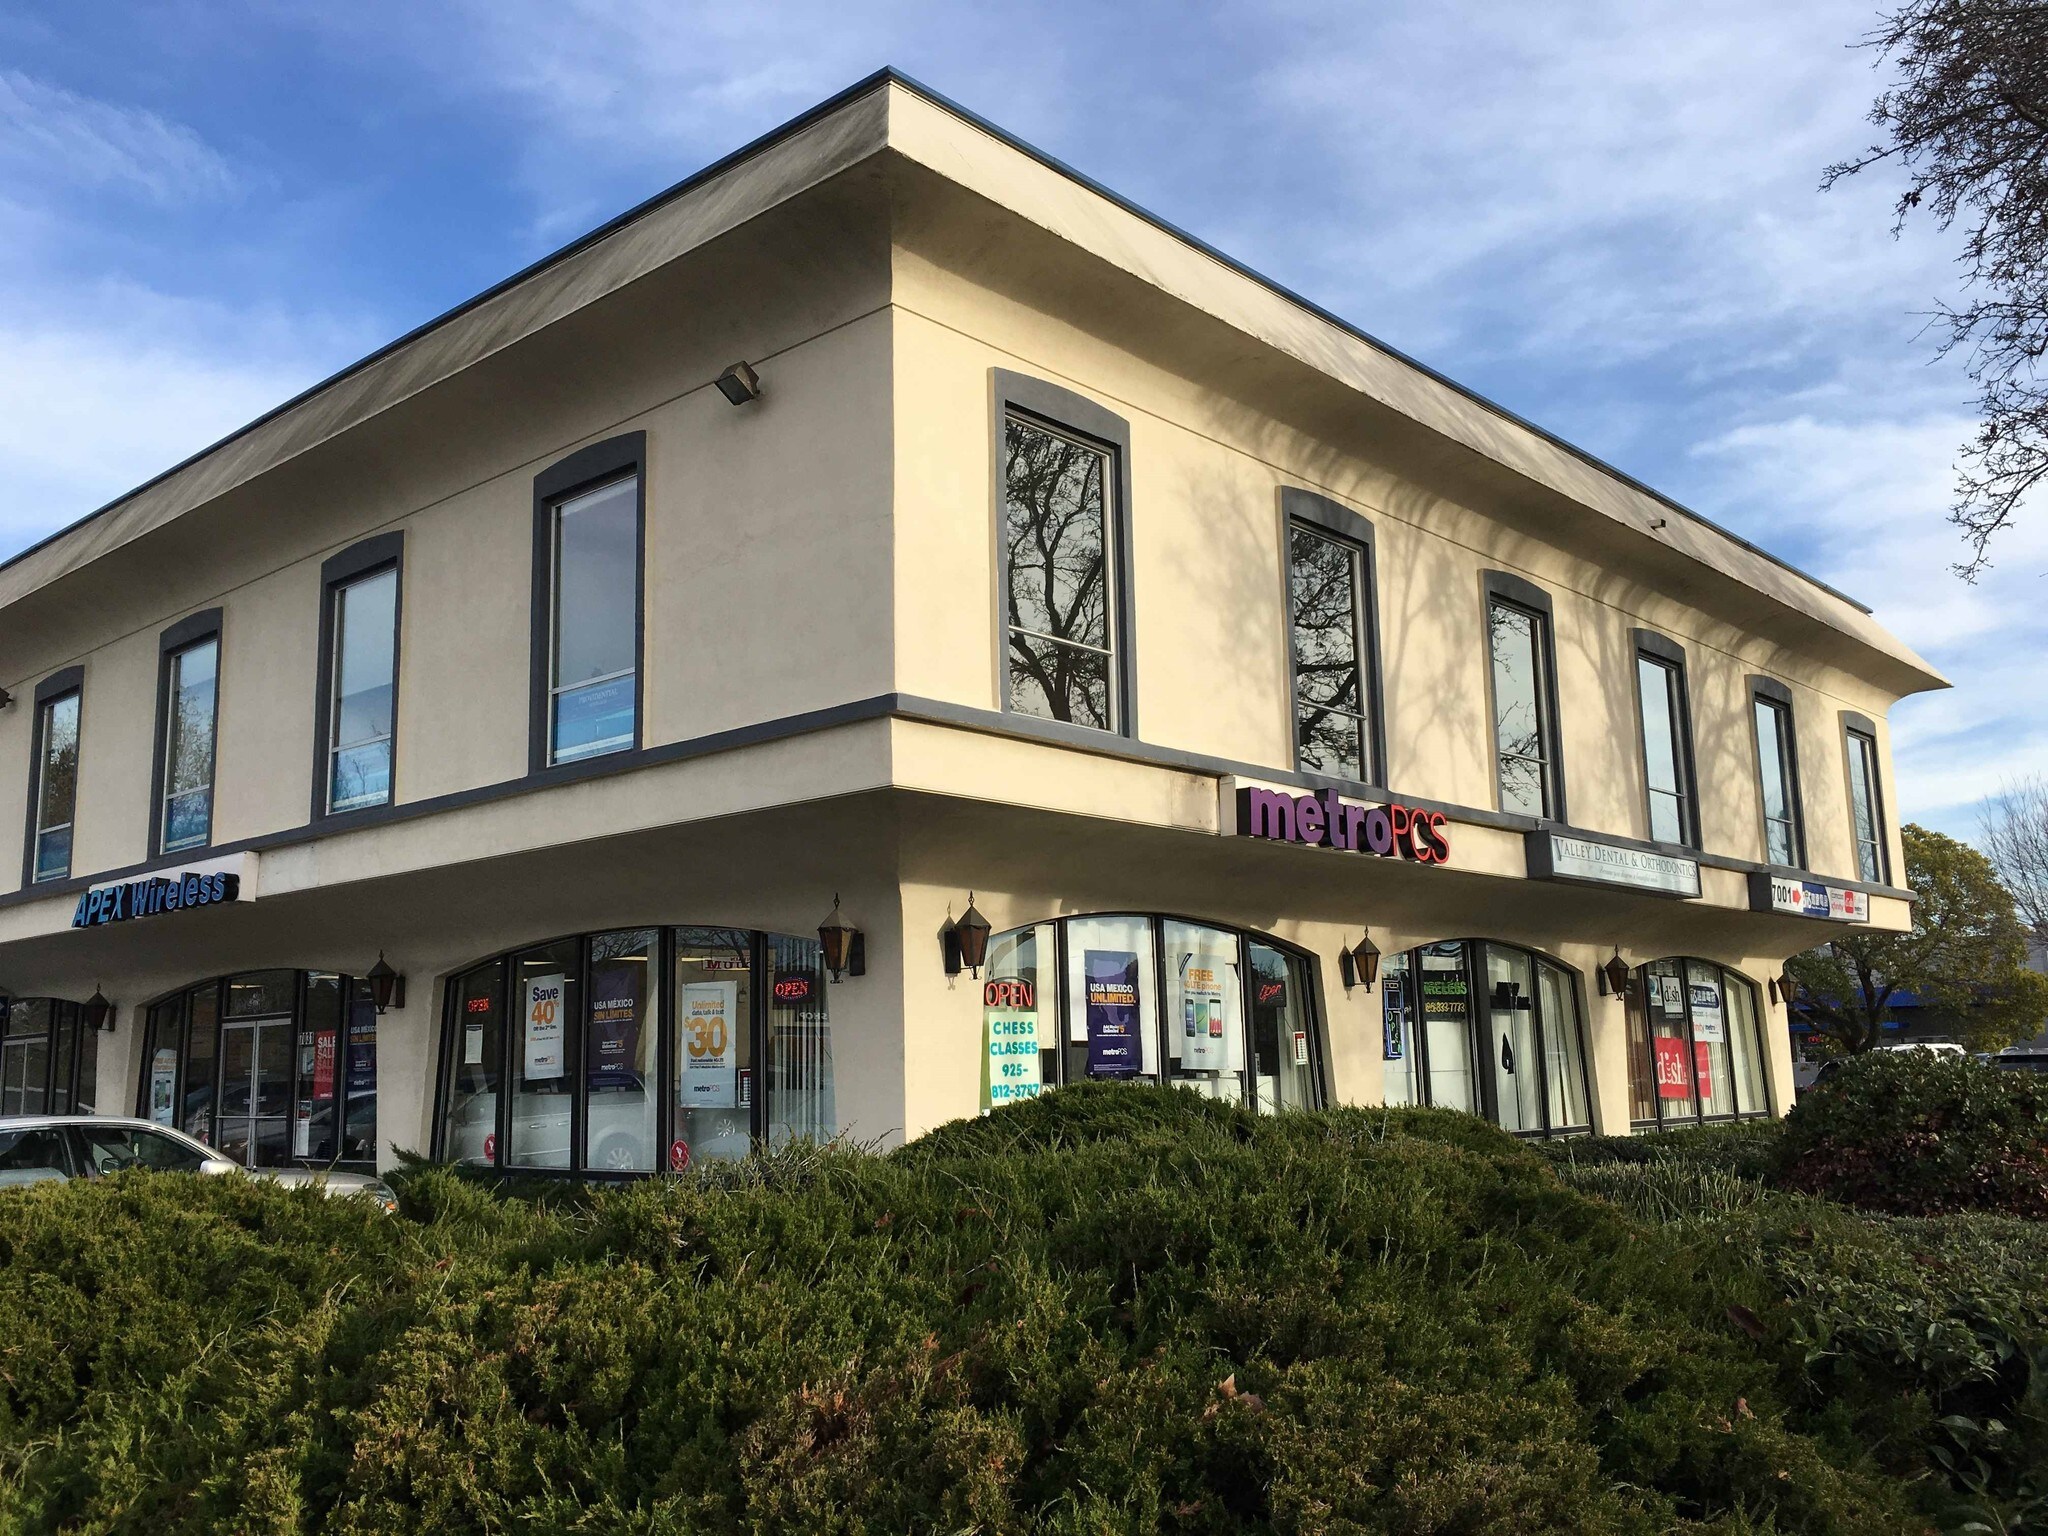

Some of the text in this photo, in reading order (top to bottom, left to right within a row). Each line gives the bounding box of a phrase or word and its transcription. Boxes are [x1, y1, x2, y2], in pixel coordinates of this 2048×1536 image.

[1249, 786, 1450, 865] metroPCS
[1553, 838, 1697, 877] VALLEY DENTAL & ORTHODONTICS
[71, 871, 226, 928] APEX Wireless
[1771, 884, 1792, 904] 7001
[1188, 968, 1214, 982] FREE
[775, 981, 808, 995] OPEN
[1090, 983, 1133, 993] USA MEXICO
[1201, 982, 1222, 991] phone
[1259, 984, 1281, 1002] Open
[532, 986, 559, 1002] Save
[986, 983, 1033, 1007] OPEN
[1090, 992, 1136, 1004] UNLIMITED.
[1664, 985, 1681, 1003] dish
[594, 998, 634, 1010] USA MÉXICO
[692, 1000, 725, 1010] Unlimited
[593, 1011, 605, 1020] SIN
[993, 1021, 1034, 1035] CHESS
[317, 1036, 336, 1048] SALE
[990, 1041, 1038, 1056] CLASSES
[1102, 1048, 1128, 1056] metroPCS
[601, 1063, 624, 1071] metroPCS
[1002, 1063, 1029, 1077] 925-
[1657, 1052, 1684, 1085] dish
